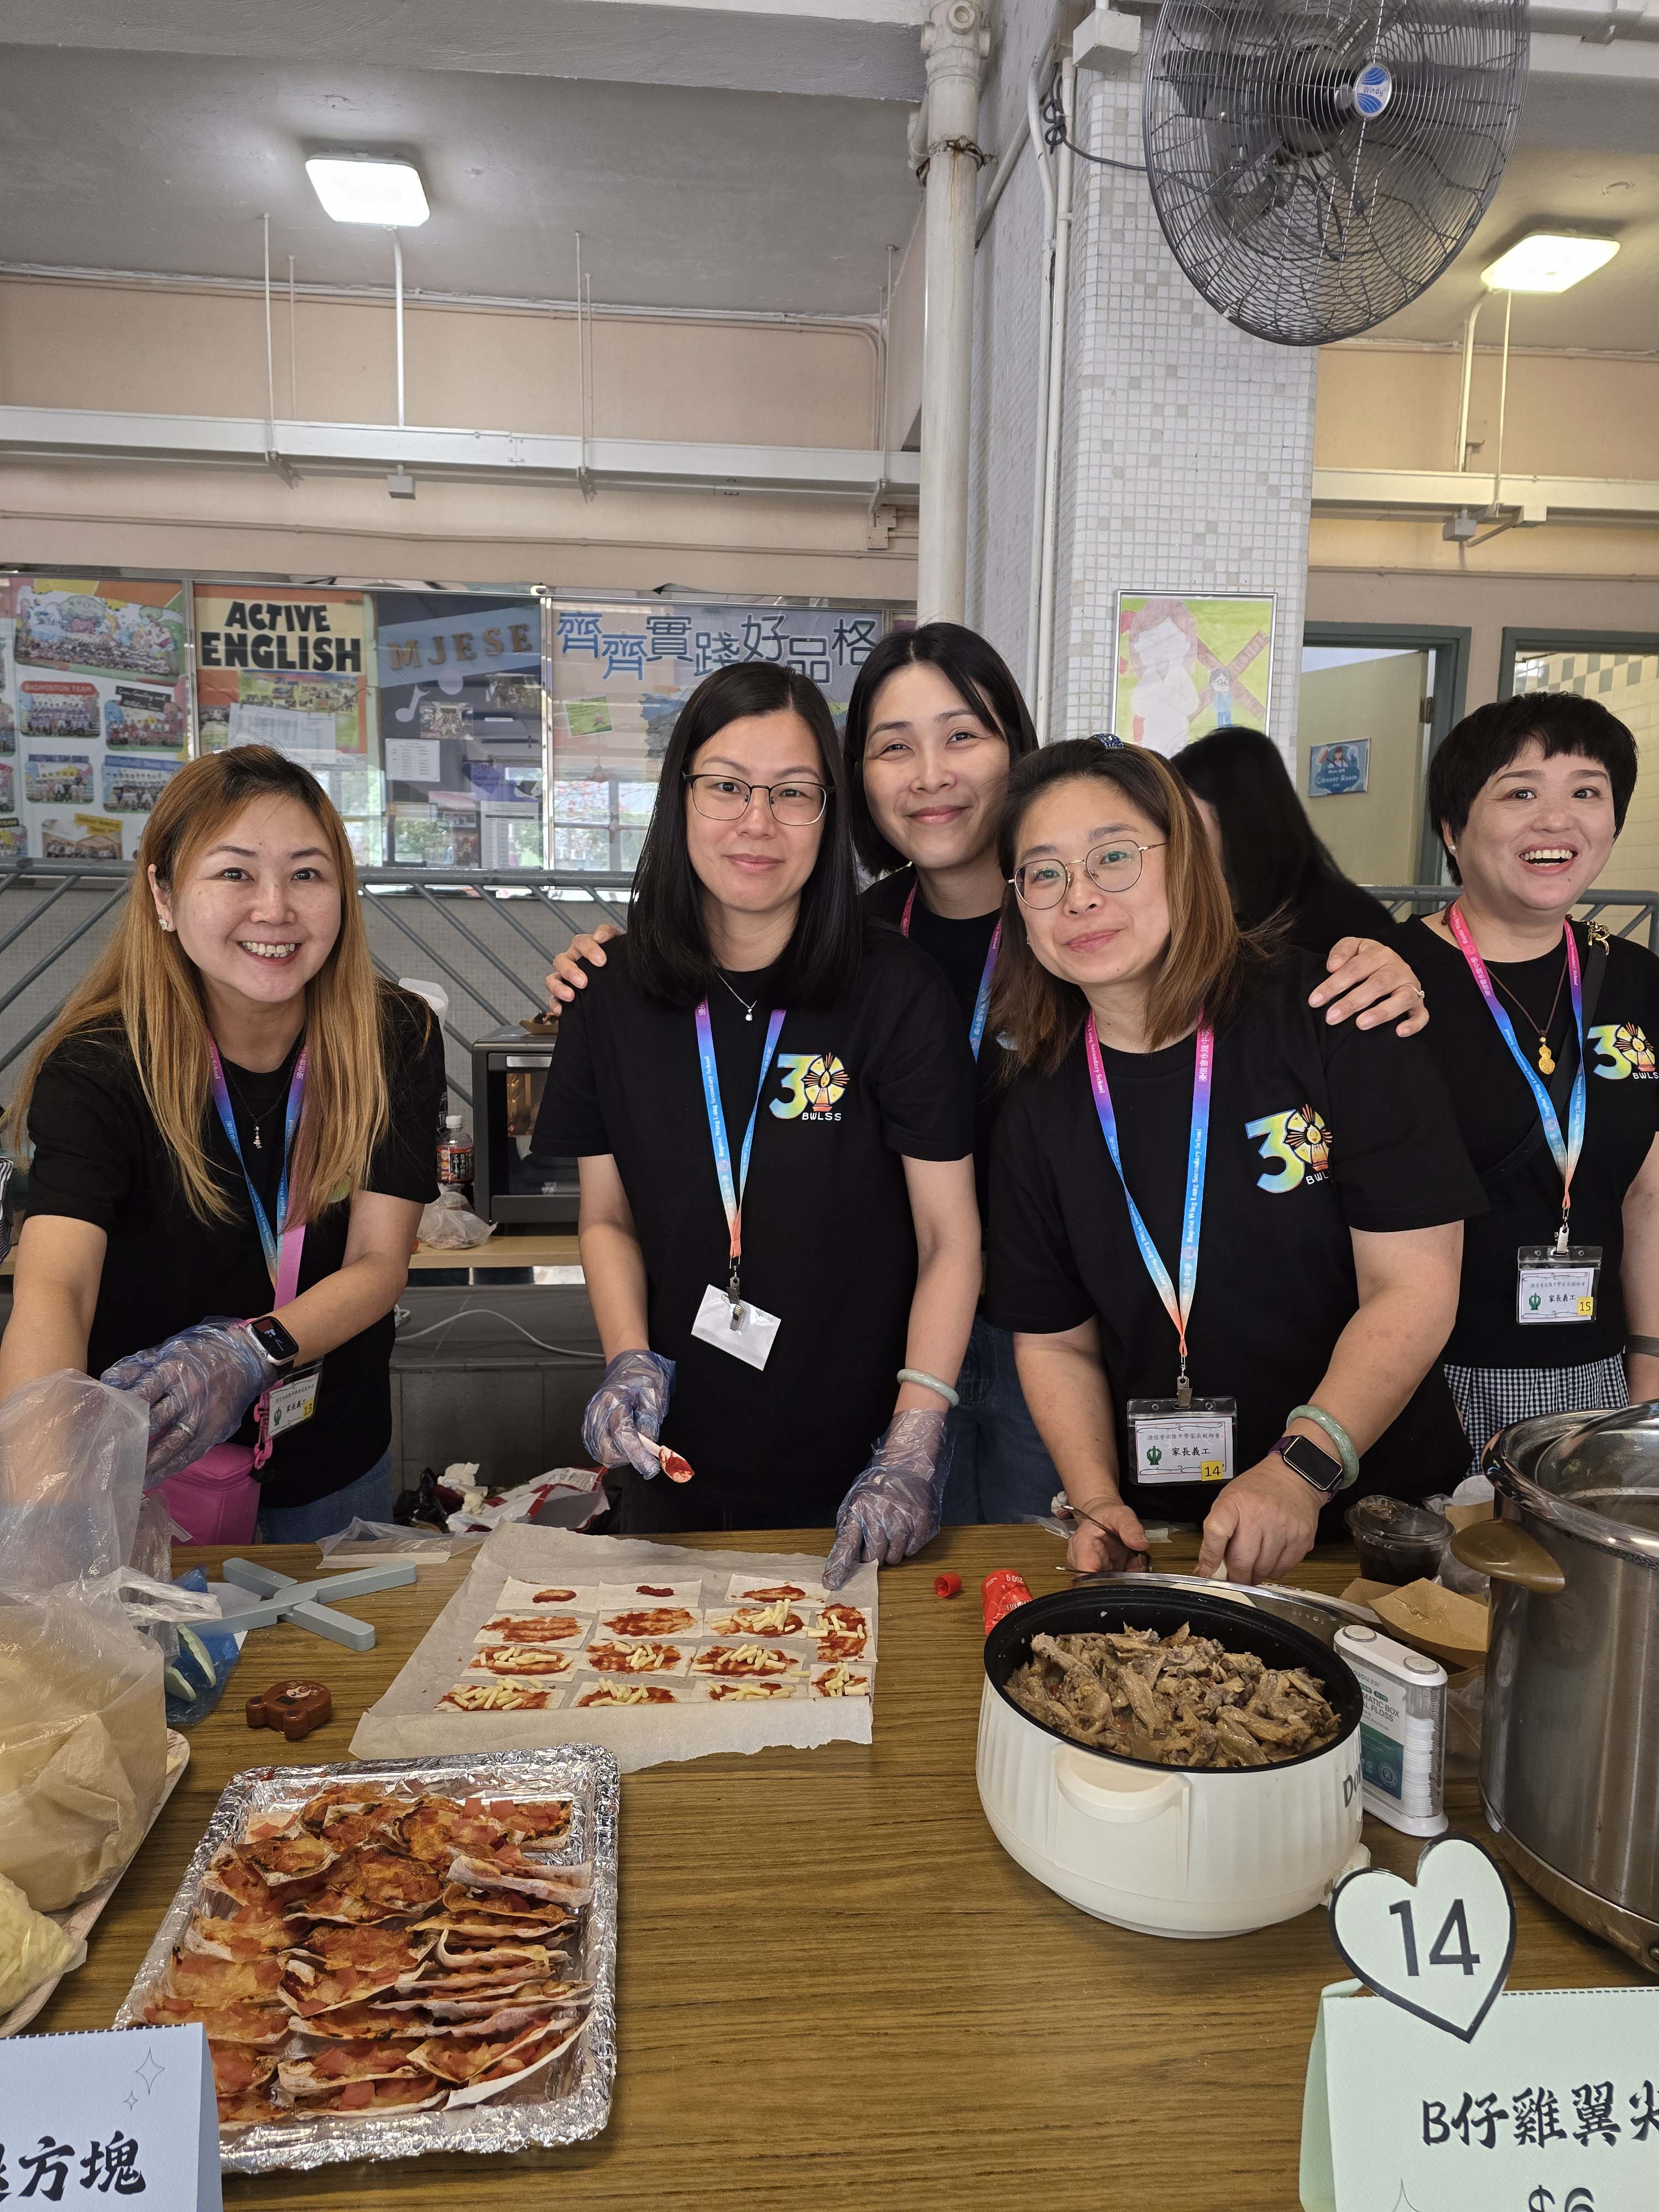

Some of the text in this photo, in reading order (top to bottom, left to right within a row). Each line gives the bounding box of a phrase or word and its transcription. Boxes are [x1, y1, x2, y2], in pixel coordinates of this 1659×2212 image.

[1363, 85, 1384, 97] Windy
[225, 601, 330, 632] ACTIVE
[201, 631, 362, 672] ENGLISH
[389, 623, 532, 670] MJESE
[557, 611, 878, 684] 齊齊實踐好品格
[212, 1061, 221, 1079] School
[1089, 1043, 1099, 1073] Secondary
[1095, 1073, 1105, 1094] School
[802, 1112, 842, 1121] BWLSS
[1187, 1128, 1203, 1243] Baptist Wing Lung Secondary School
[1129, 1203, 1139, 1225] Baptist
[1137, 1224, 1146, 1243] Wing
[1144, 1241, 1154, 1259] Lung
[1151, 1257, 1168, 1288] Secondary
[1548, 1293, 1576, 1303] 家長義工
[1579, 1301, 1591, 1312] 15
[304, 1404, 312, 1416] 13
[1171, 1447, 1211, 1456] 家長義工
[1204, 1465, 1221, 1477] 14
[1011, 1575, 1024, 1584] 200
[1371, 1705, 1394, 1722] FLOSS
[1385, 1704, 1400, 1718] BOX
[1389, 1898, 1480, 1976] 14
